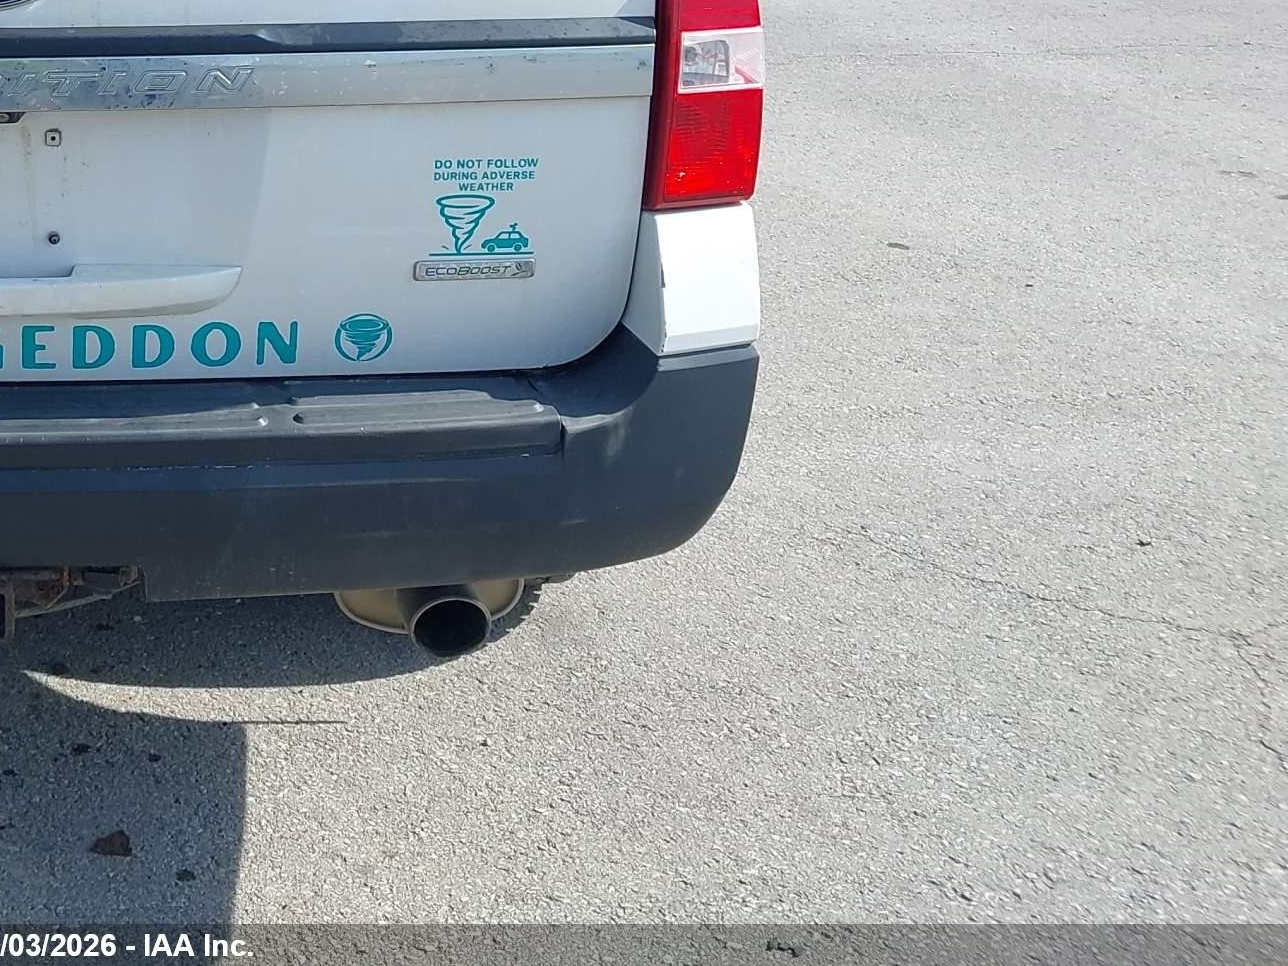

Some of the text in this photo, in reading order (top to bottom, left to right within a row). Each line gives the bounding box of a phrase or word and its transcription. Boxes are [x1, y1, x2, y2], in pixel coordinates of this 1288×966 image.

[434, 158, 539, 170] DO NOT FOLLOW
[433, 170, 536, 181] DURING ADVERSE
[458, 182, 514, 191] WEATHER
